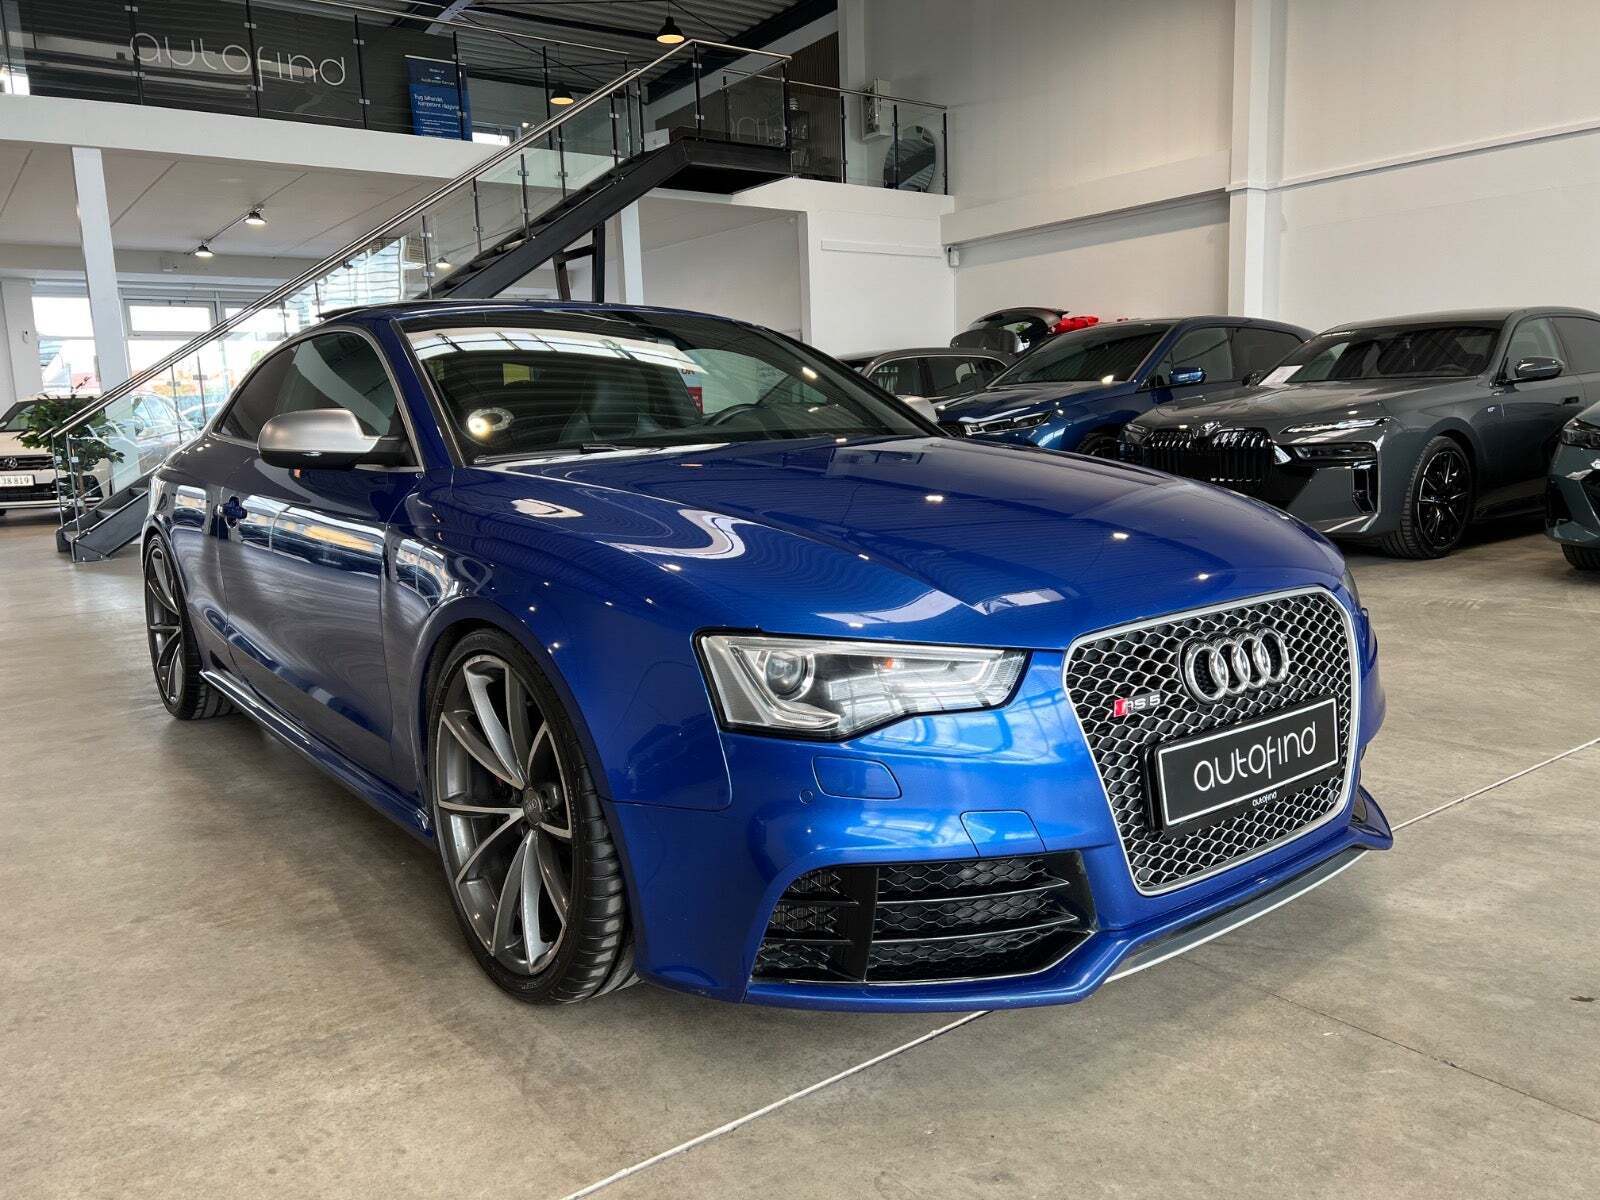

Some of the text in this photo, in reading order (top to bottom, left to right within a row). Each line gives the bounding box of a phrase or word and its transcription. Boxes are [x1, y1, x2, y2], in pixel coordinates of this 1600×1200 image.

[129, 32, 346, 91] autofind
[1193, 721, 1316, 792] autofind
[1252, 791, 1278, 807] autofind
